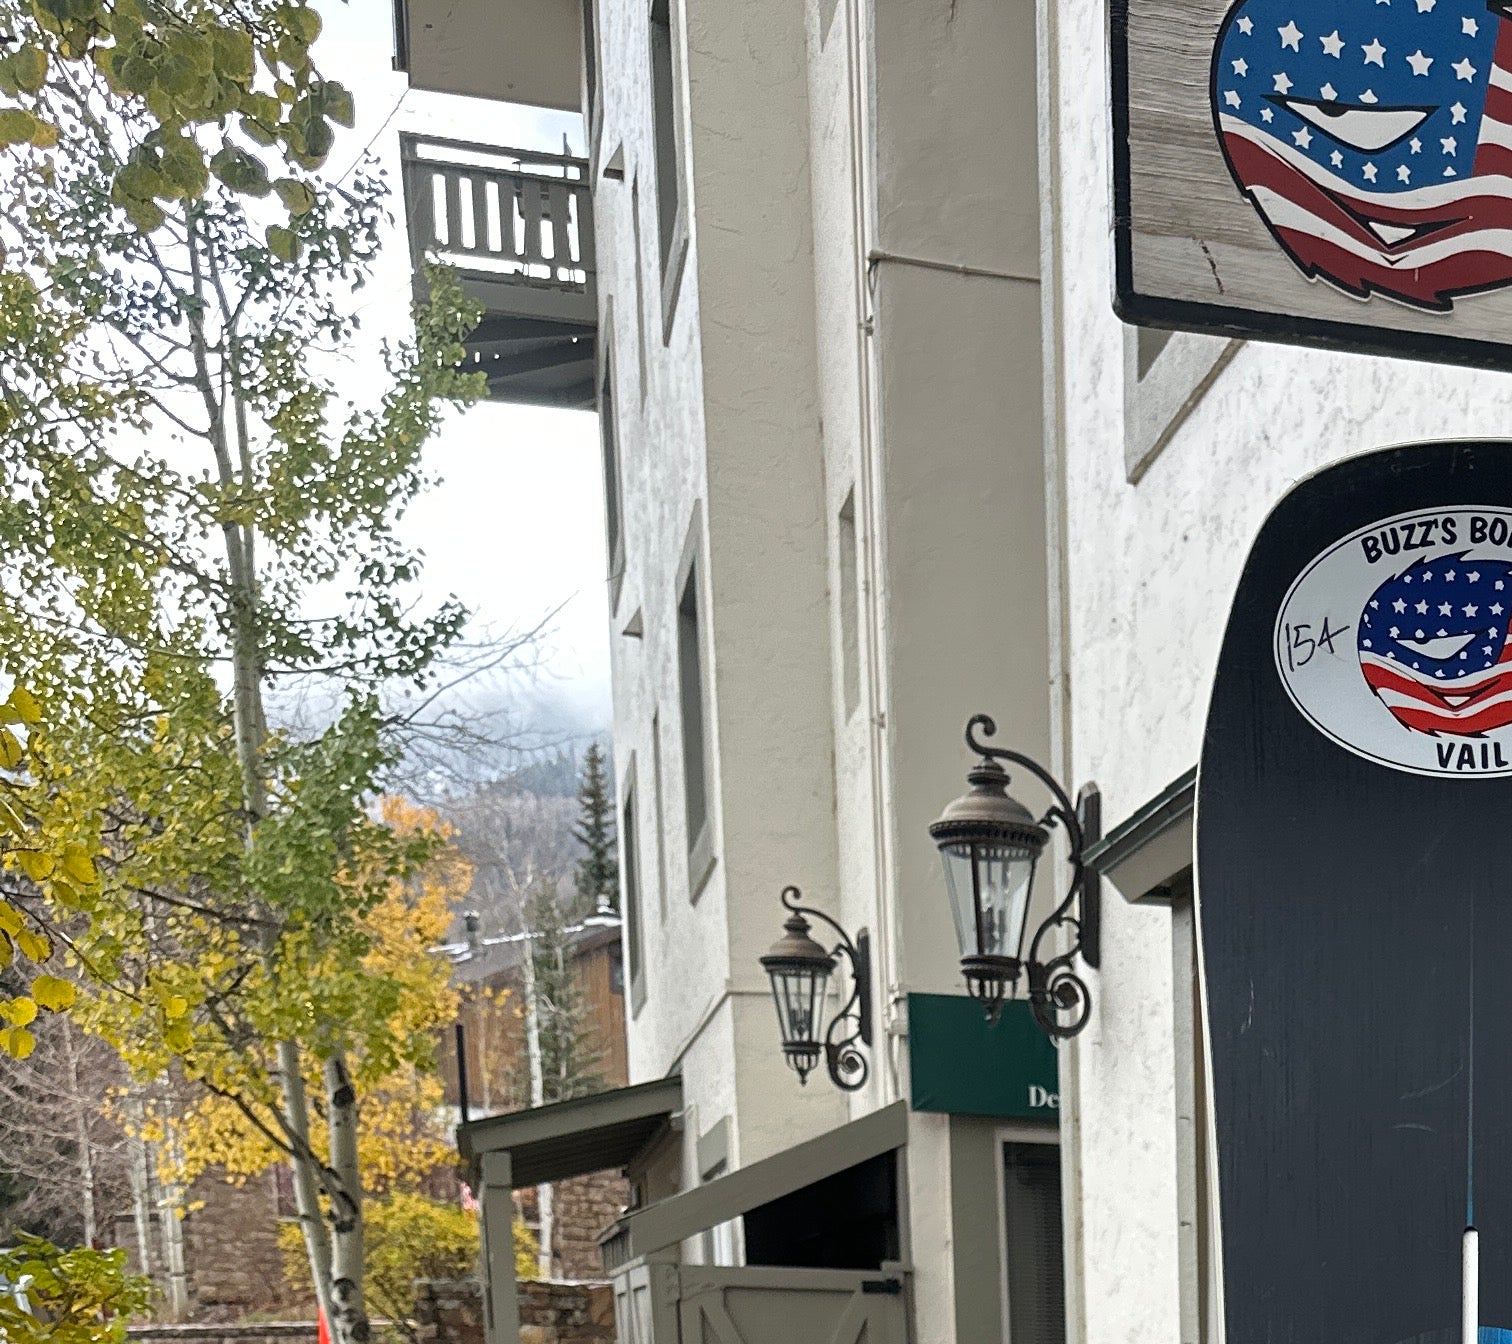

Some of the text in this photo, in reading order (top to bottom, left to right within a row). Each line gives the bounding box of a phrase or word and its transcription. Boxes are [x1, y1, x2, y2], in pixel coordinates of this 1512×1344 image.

[1361, 518, 1457, 563] BUZZ'S
[1285, 617, 1350, 672] 154
[1436, 742, 1508, 770] VAIL
